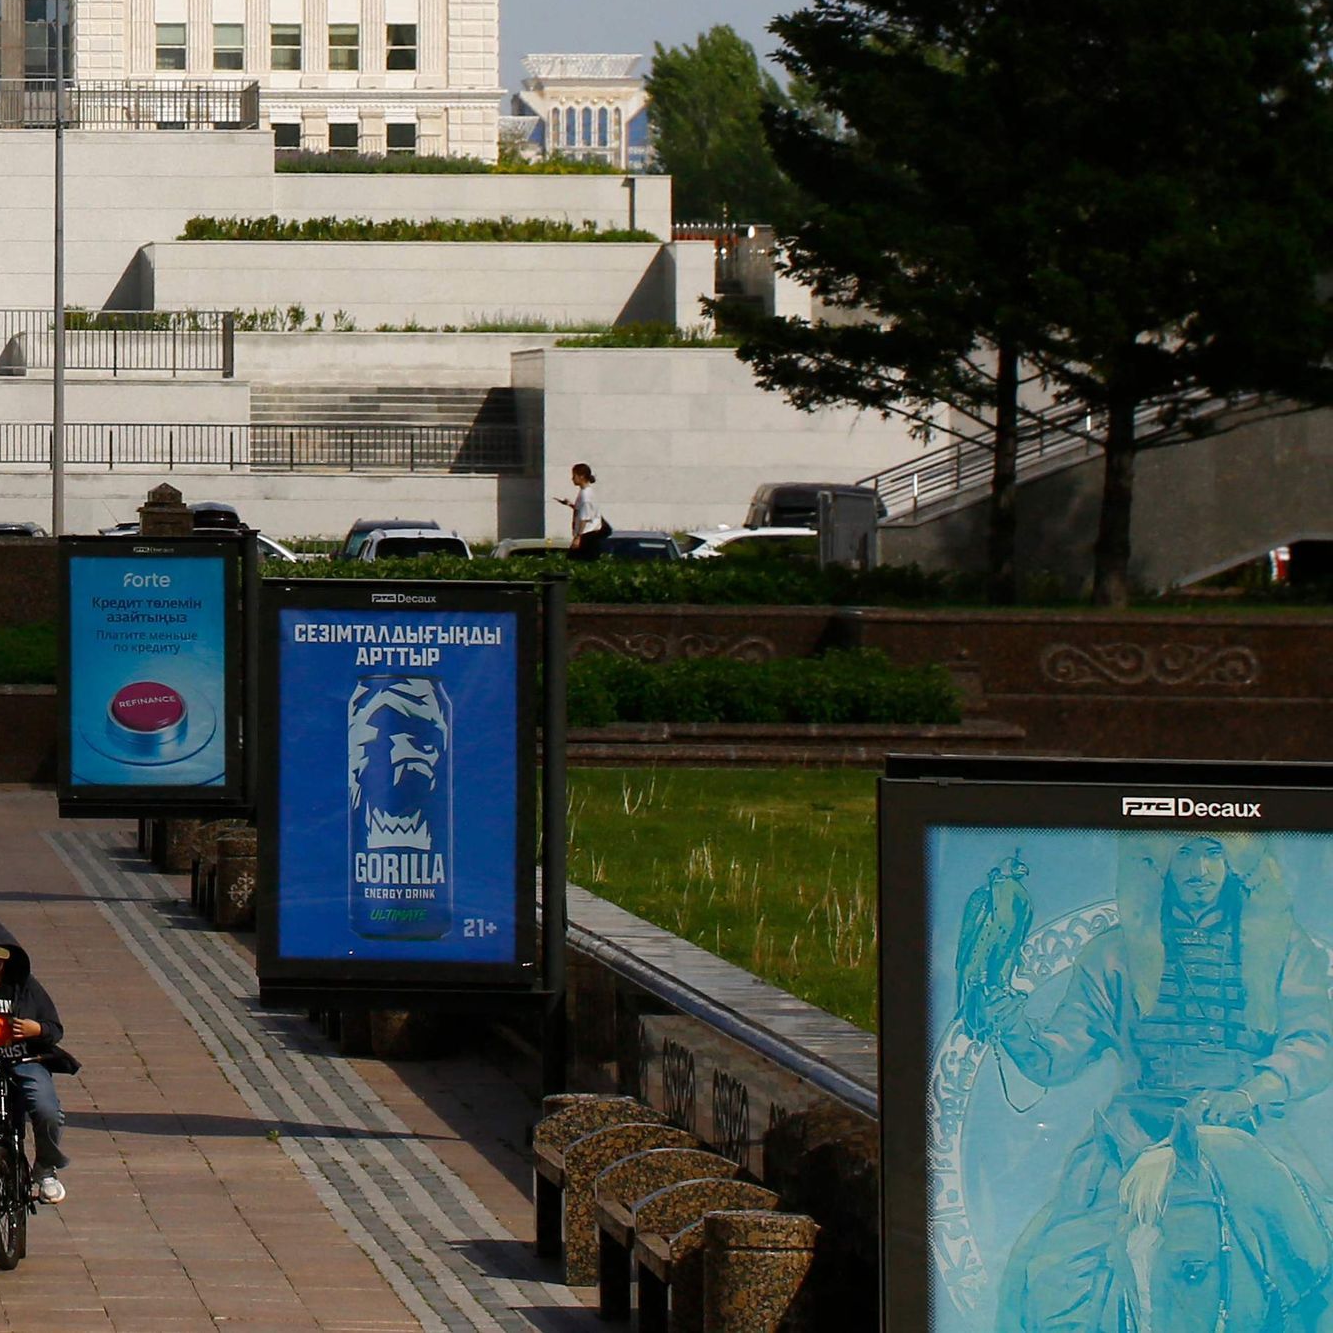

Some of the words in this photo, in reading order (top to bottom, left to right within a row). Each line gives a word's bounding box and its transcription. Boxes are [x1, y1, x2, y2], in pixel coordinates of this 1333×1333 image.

[92, 597, 142, 611] Кредит
[146, 597, 202, 609] төлемін
[397, 594, 436, 603] Decaux
[107, 612, 187, 625] азайтыңыз
[96, 630, 146, 641] Платите
[149, 632, 198, 641] меньше
[294, 624, 501, 646] СЕЗІМТАЛДЫҒЫҢДЫ
[114, 644, 128, 652] по
[132, 643, 180, 655] кредиту
[356, 647, 440, 666] АРТТЫР
[119, 695, 177, 708] REFINANCE
[1178, 798, 1261, 817] Decaux
[355, 853, 445, 884] GORILLA
[364, 888, 403, 899] ENERGY
[405, 889, 436, 899] DRINK
[463, 918, 497, 937] 21+
